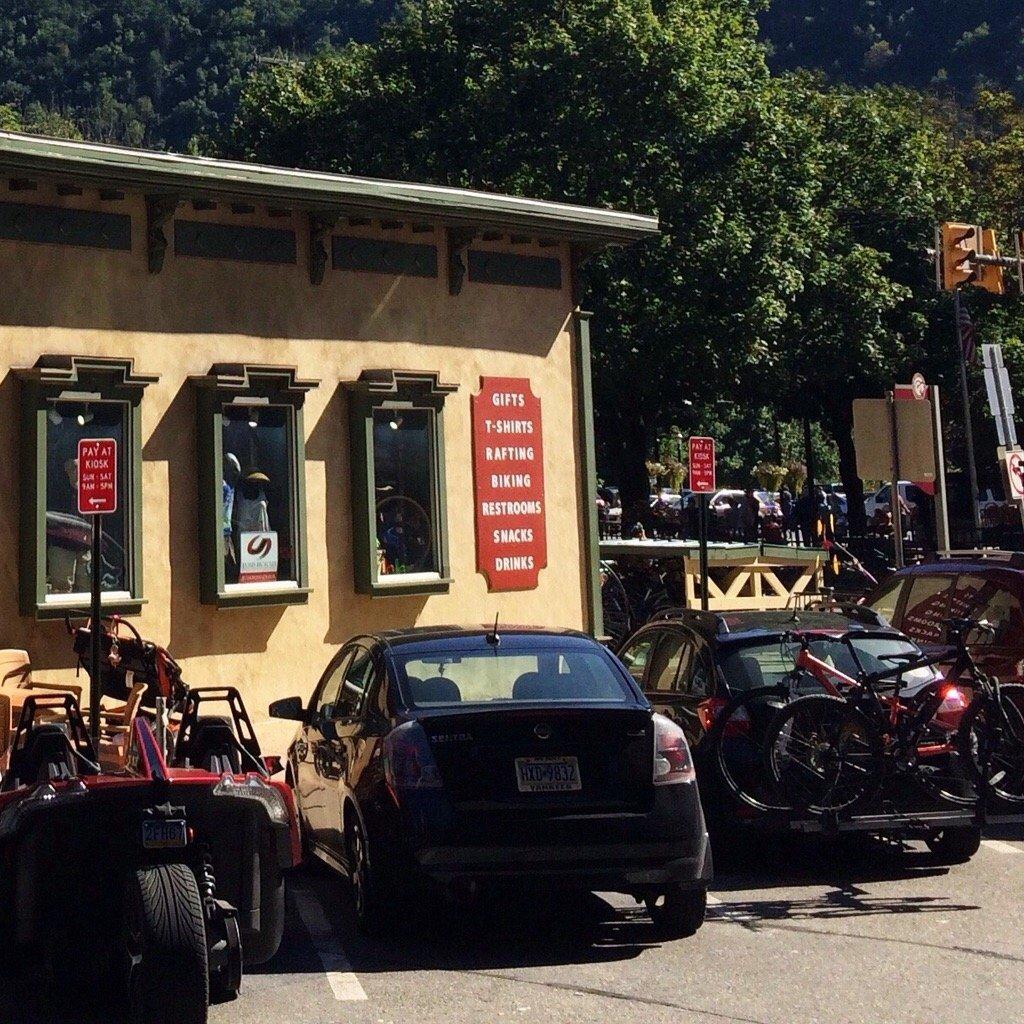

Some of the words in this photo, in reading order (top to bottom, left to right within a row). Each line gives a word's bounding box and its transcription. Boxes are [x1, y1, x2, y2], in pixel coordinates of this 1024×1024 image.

[492, 393, 525, 407] GIFTS
[485, 420, 534, 434] T-SHIRTS
[82, 447, 99, 457] PAY
[101, 447, 113, 456] AT
[485, 447, 534, 461] RAFTING
[85, 459, 109, 469] KIOSK
[491, 474, 531, 488] BIKING
[482, 501, 542, 516] RESTROOMS
[493, 528, 534, 544] SNACKS
[495, 556, 534, 572] DRINKS
